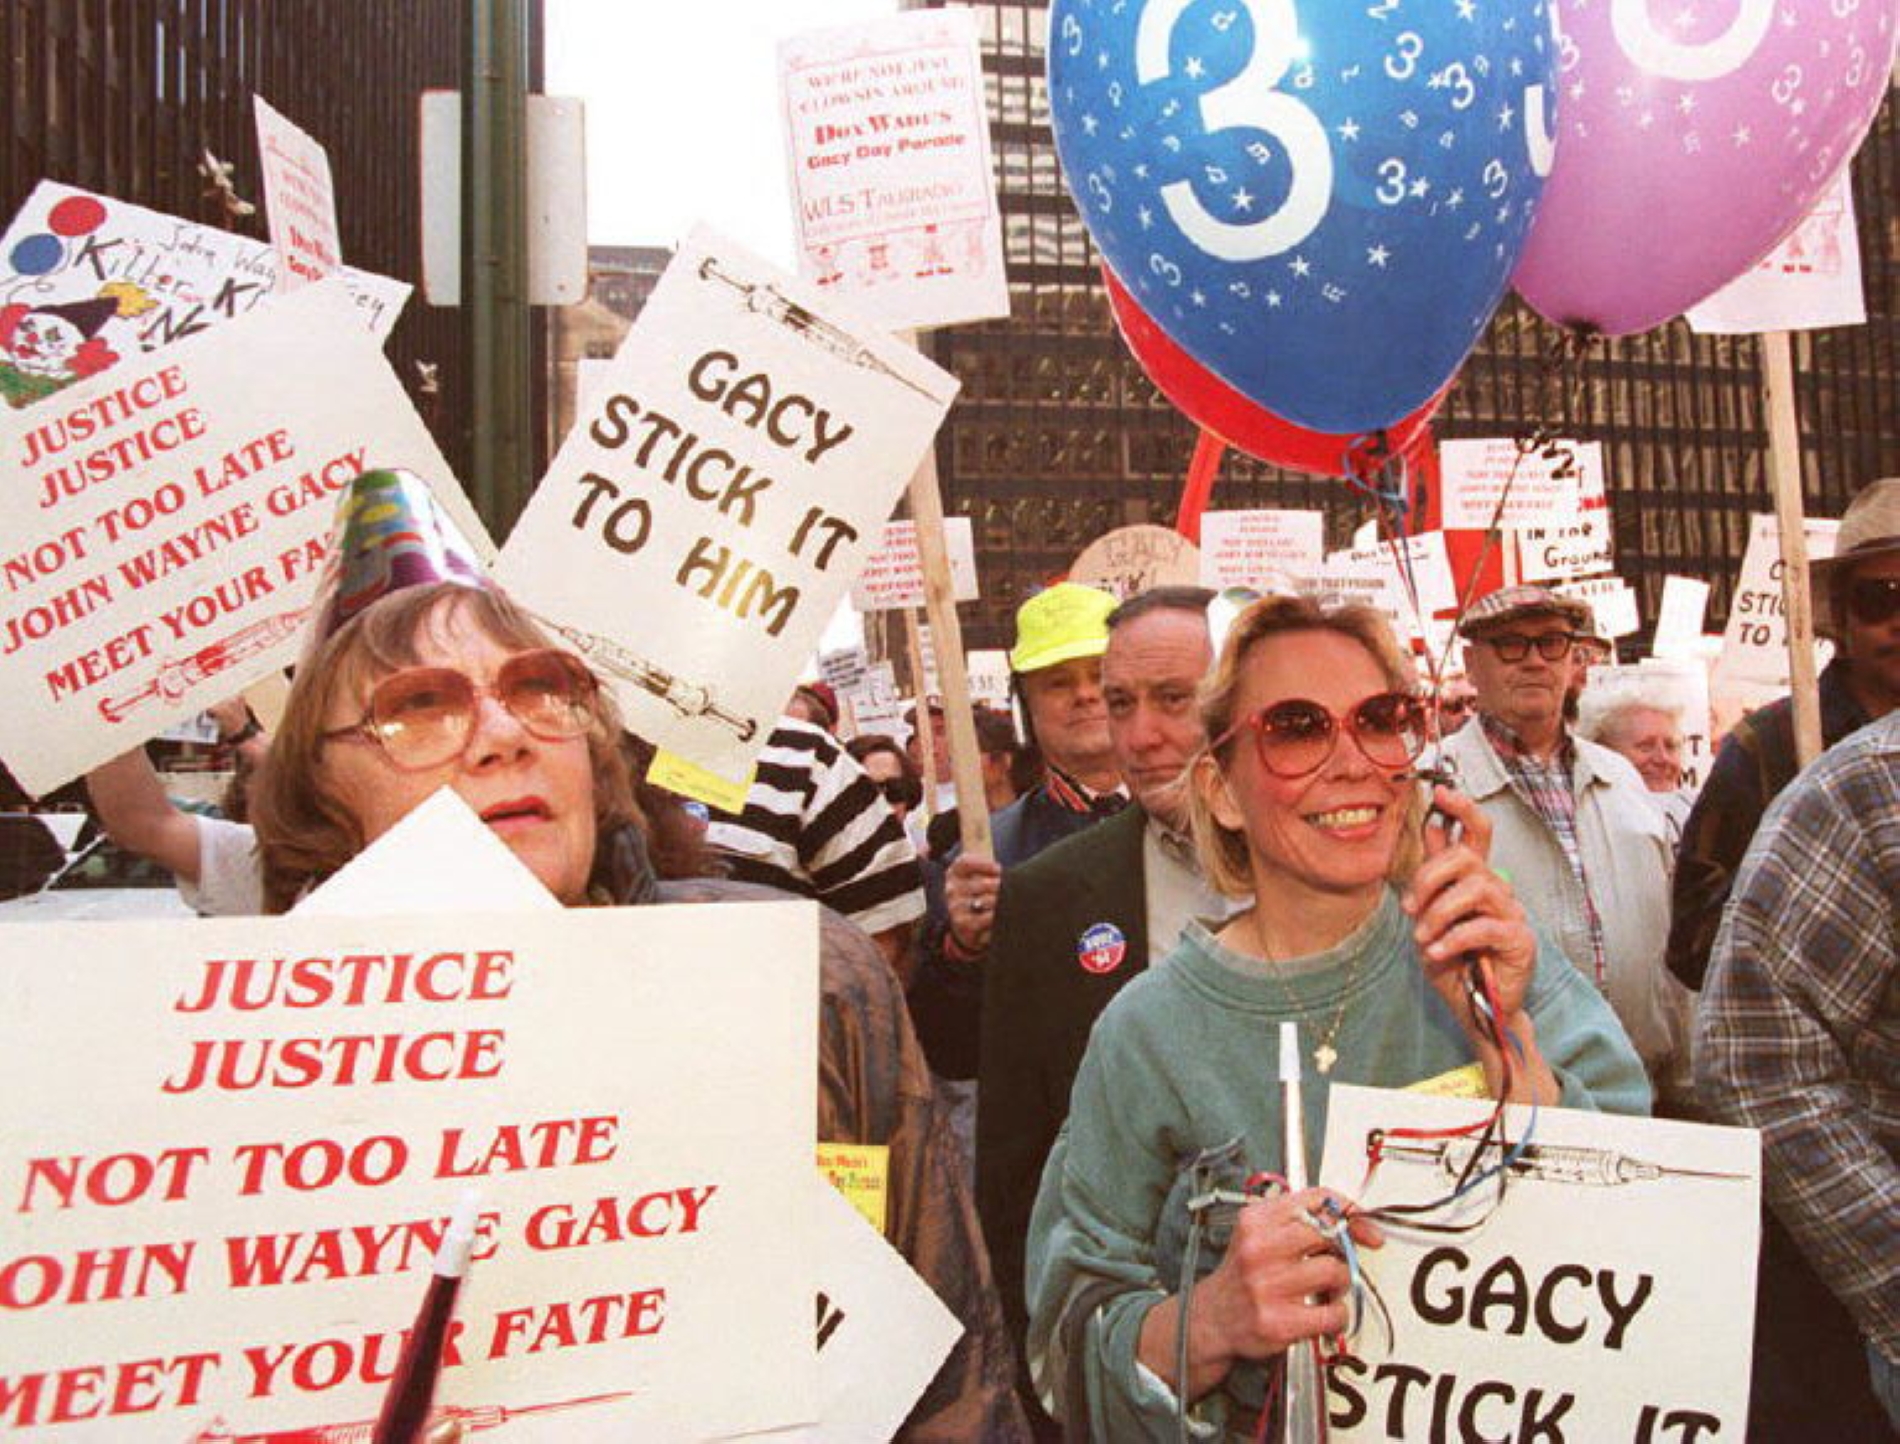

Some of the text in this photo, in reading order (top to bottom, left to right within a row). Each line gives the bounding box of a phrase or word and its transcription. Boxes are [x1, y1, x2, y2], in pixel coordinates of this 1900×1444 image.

[1383, 30, 1424, 80] 3
[1443, 62, 1477, 109] 3
[1136, 0, 1335, 261] 3
[1483, 159, 1507, 198] 3
[1376, 157, 1407, 205] 3
[1151, 253, 1182, 286] 3
[21, 366, 188, 467] JUSTICE
[687, 350, 854, 464] GACY
[39, 408, 208, 508] JUSTICE
[590, 393, 858, 571] STICK IT
[2, 429, 295, 592] NOT TOO LATE
[2, 447, 368, 655] JOHN WAYNE GACY
[572, 471, 800, 637] TO HIM
[45, 623, 153, 702] MEET
[160, 564, 276, 640] YOUR
[1739, 591, 1787, 616] STI
[1739, 623, 1770, 646] TO
[175, 950, 515, 1013] JUSTICE
[163, 1028, 506, 1094] JUSTICE
[20, 1114, 620, 1213] NOT TOO LATE
[225, 1210, 501, 1289] WAYNE
[525, 1185, 719, 1252] GACY
[487, 1288, 666, 1361] FATE
[1410, 1246, 1655, 1350] GACY
[1325, 1354, 1577, 1444] STICK
